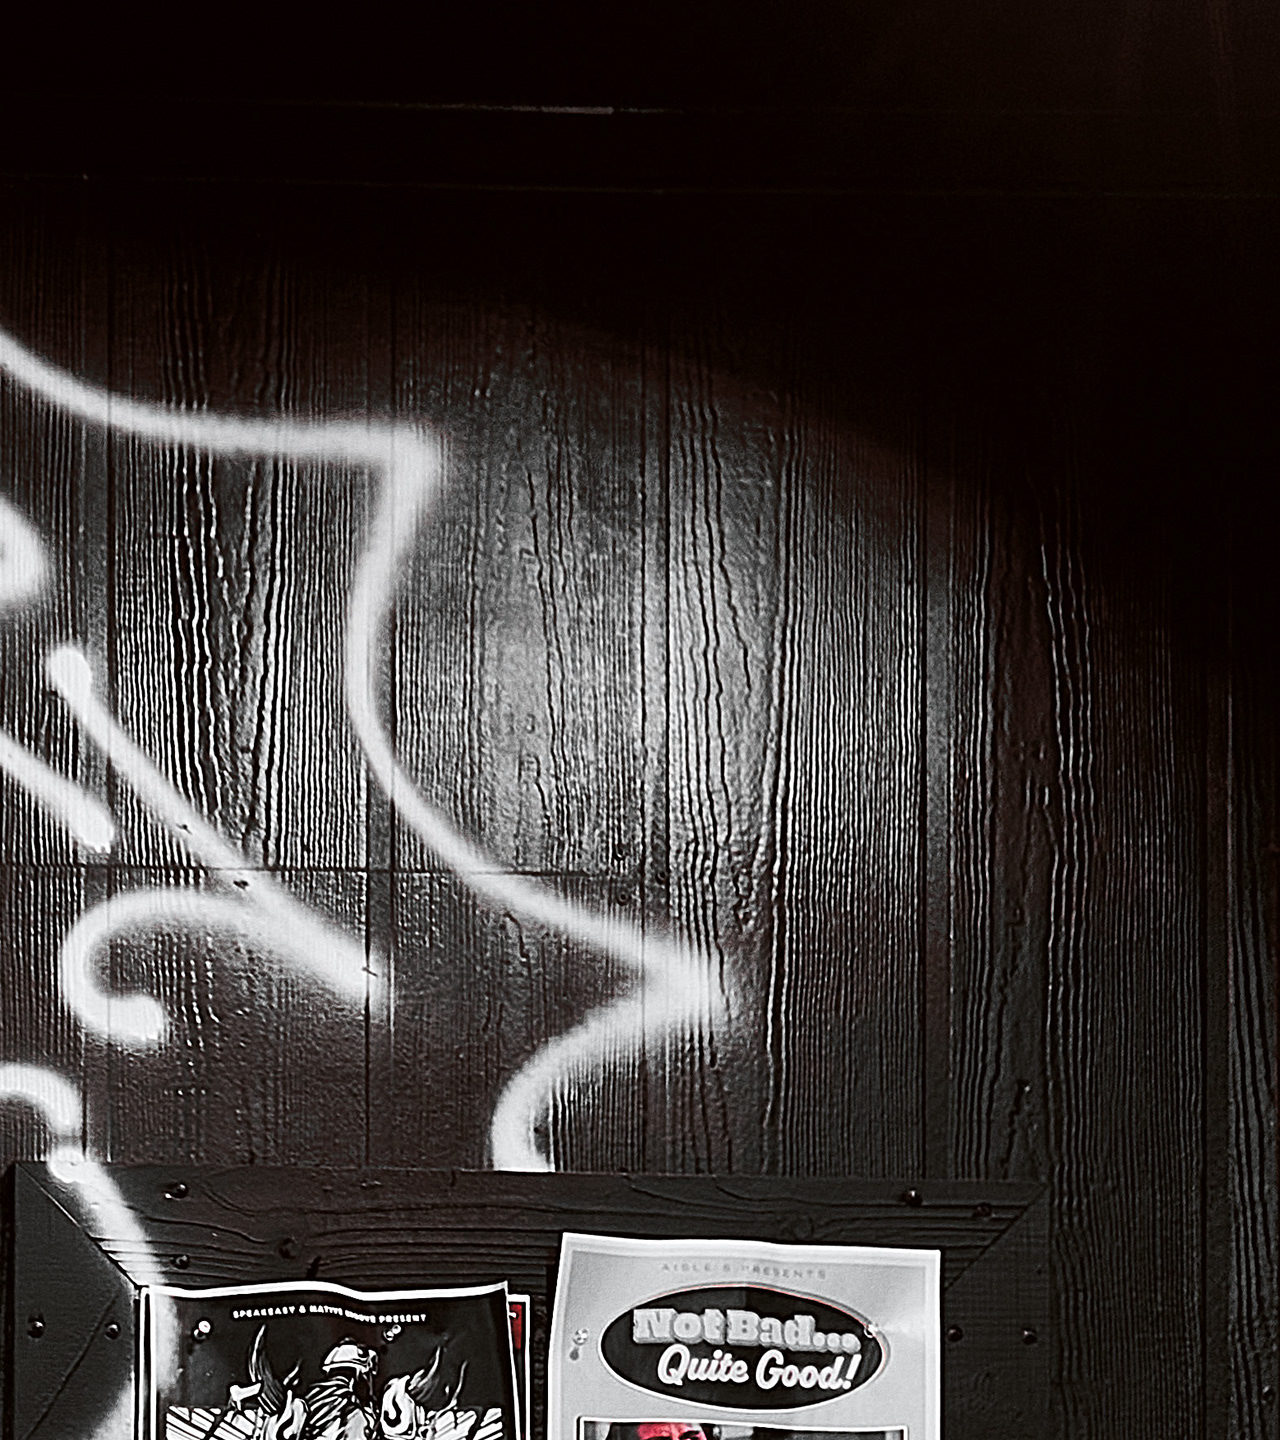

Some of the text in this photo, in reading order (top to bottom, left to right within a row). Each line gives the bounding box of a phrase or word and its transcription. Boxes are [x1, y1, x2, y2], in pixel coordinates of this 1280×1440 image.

[633, 1308, 861, 1353] Not Bad...
[657, 1344, 862, 1390] Quite Good!
